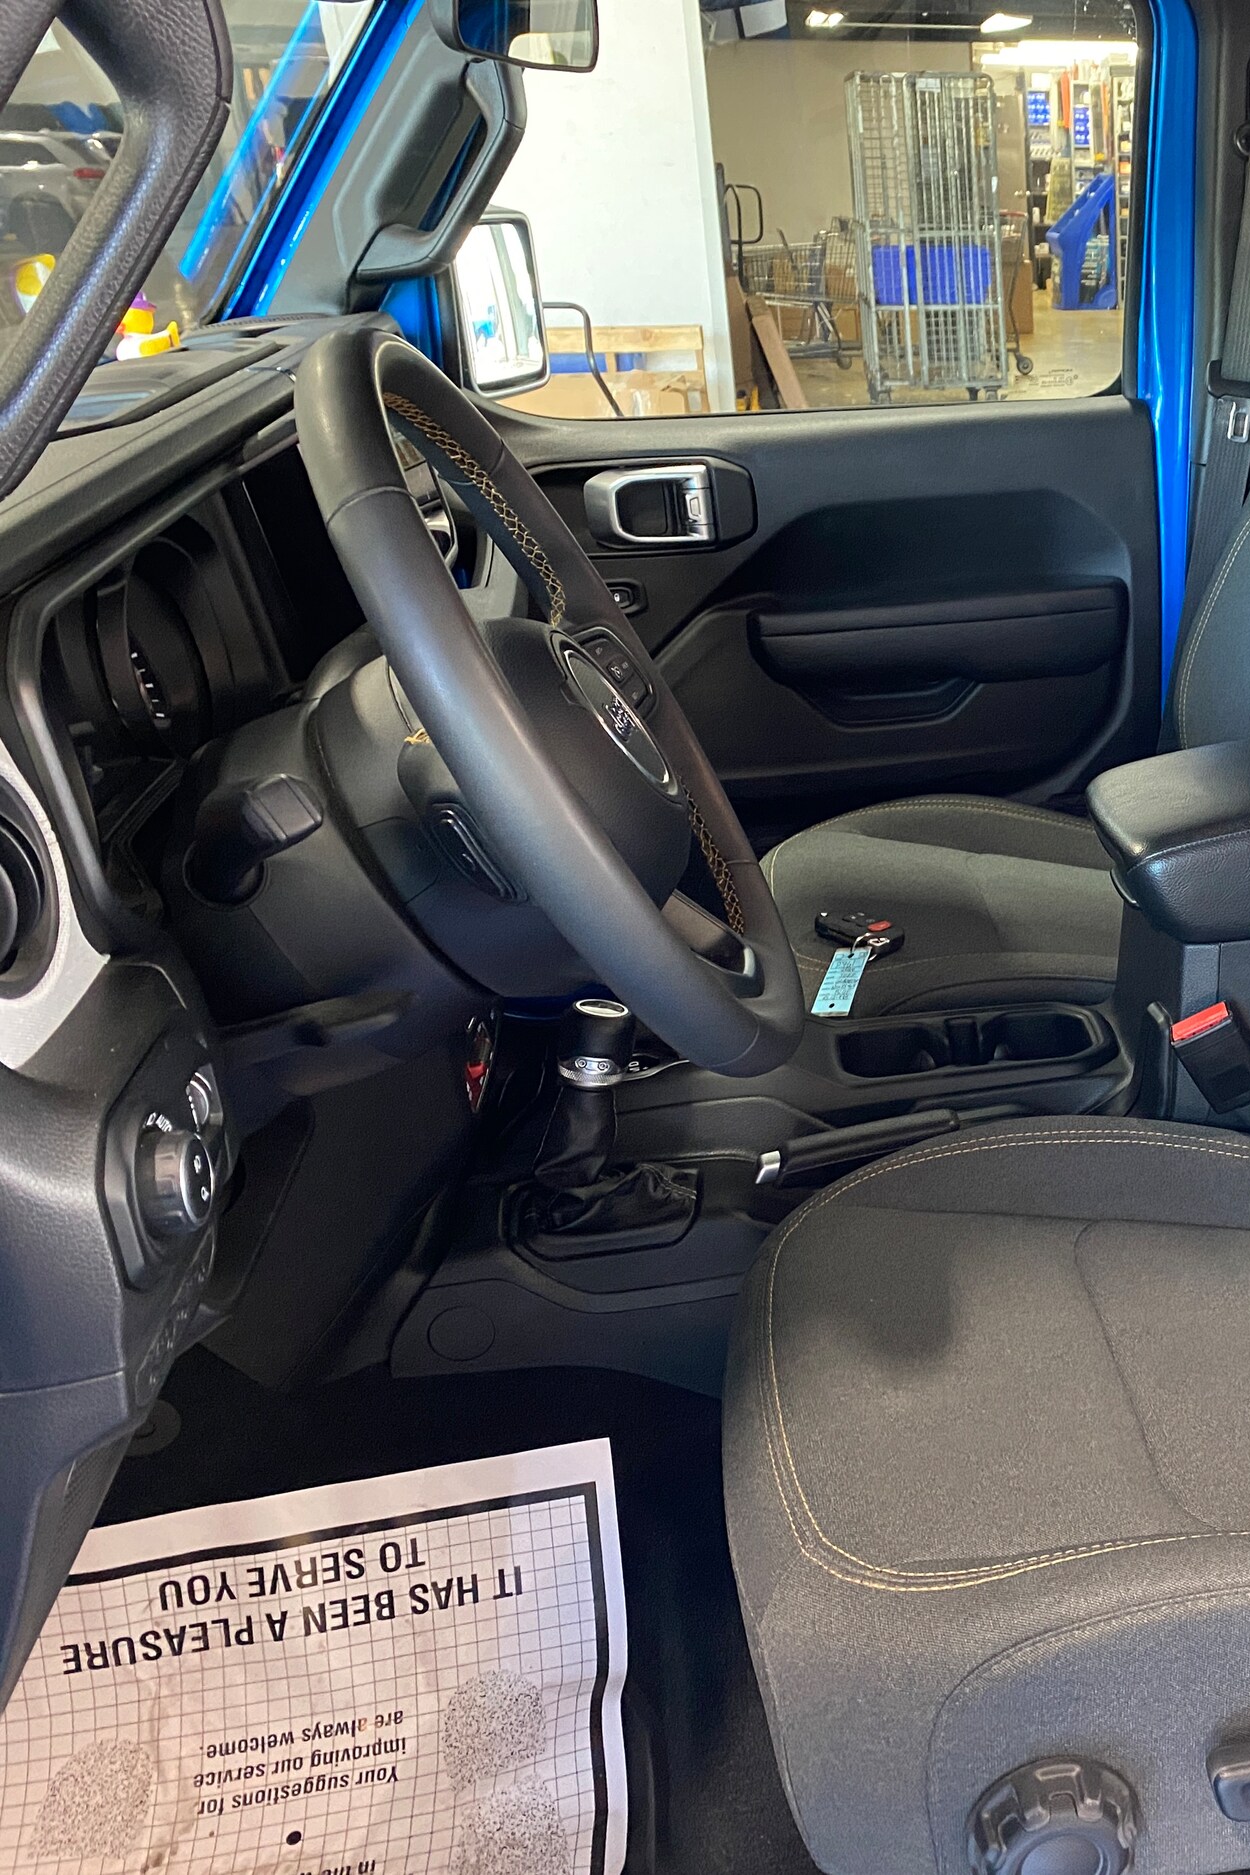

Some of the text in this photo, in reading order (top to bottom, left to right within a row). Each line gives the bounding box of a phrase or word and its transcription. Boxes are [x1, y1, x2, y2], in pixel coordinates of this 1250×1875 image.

[158, 1538, 425, 1611] TO SERVE YOU
[60, 1565, 523, 1675] IT HAS BEEN A PLEASURE
[199, 1710, 404, 1759] are always welcome.
[193, 1737, 406, 1789] improving our service
[197, 1766, 398, 1816] Your suggestions for
